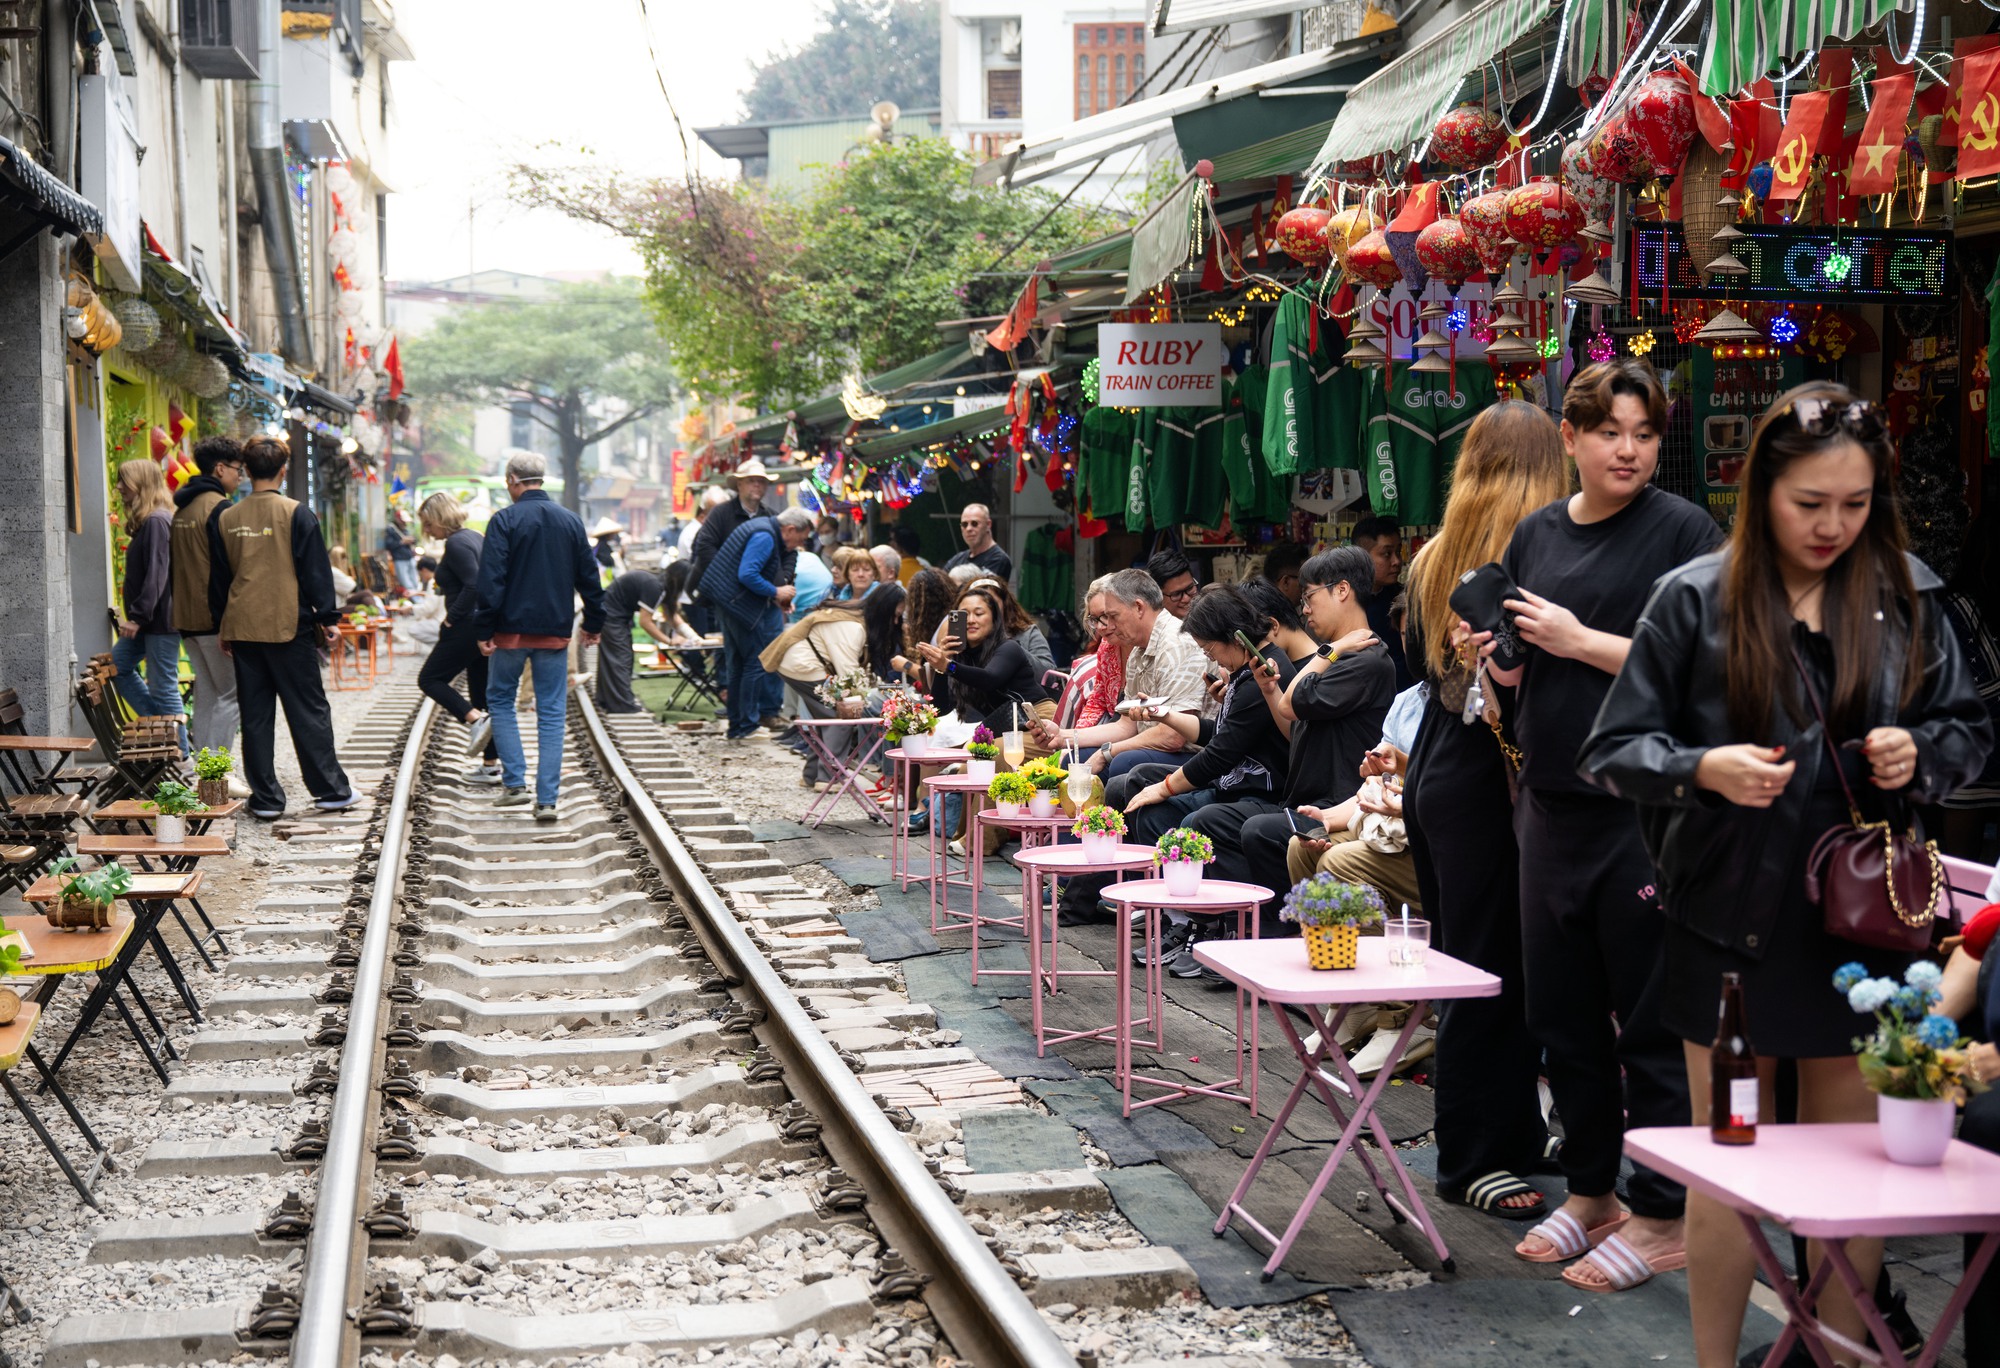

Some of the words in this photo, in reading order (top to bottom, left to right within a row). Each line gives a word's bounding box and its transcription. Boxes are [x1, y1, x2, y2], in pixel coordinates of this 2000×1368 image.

[1117, 339, 1204, 366] RUBY
[1105, 374, 1153, 391] TRAIN
[1156, 374, 1216, 390] COFFEE
[1404, 387, 1466, 409] Grab
[1129, 465, 1145, 515] Grab
[1637, 883, 1658, 901] FO
